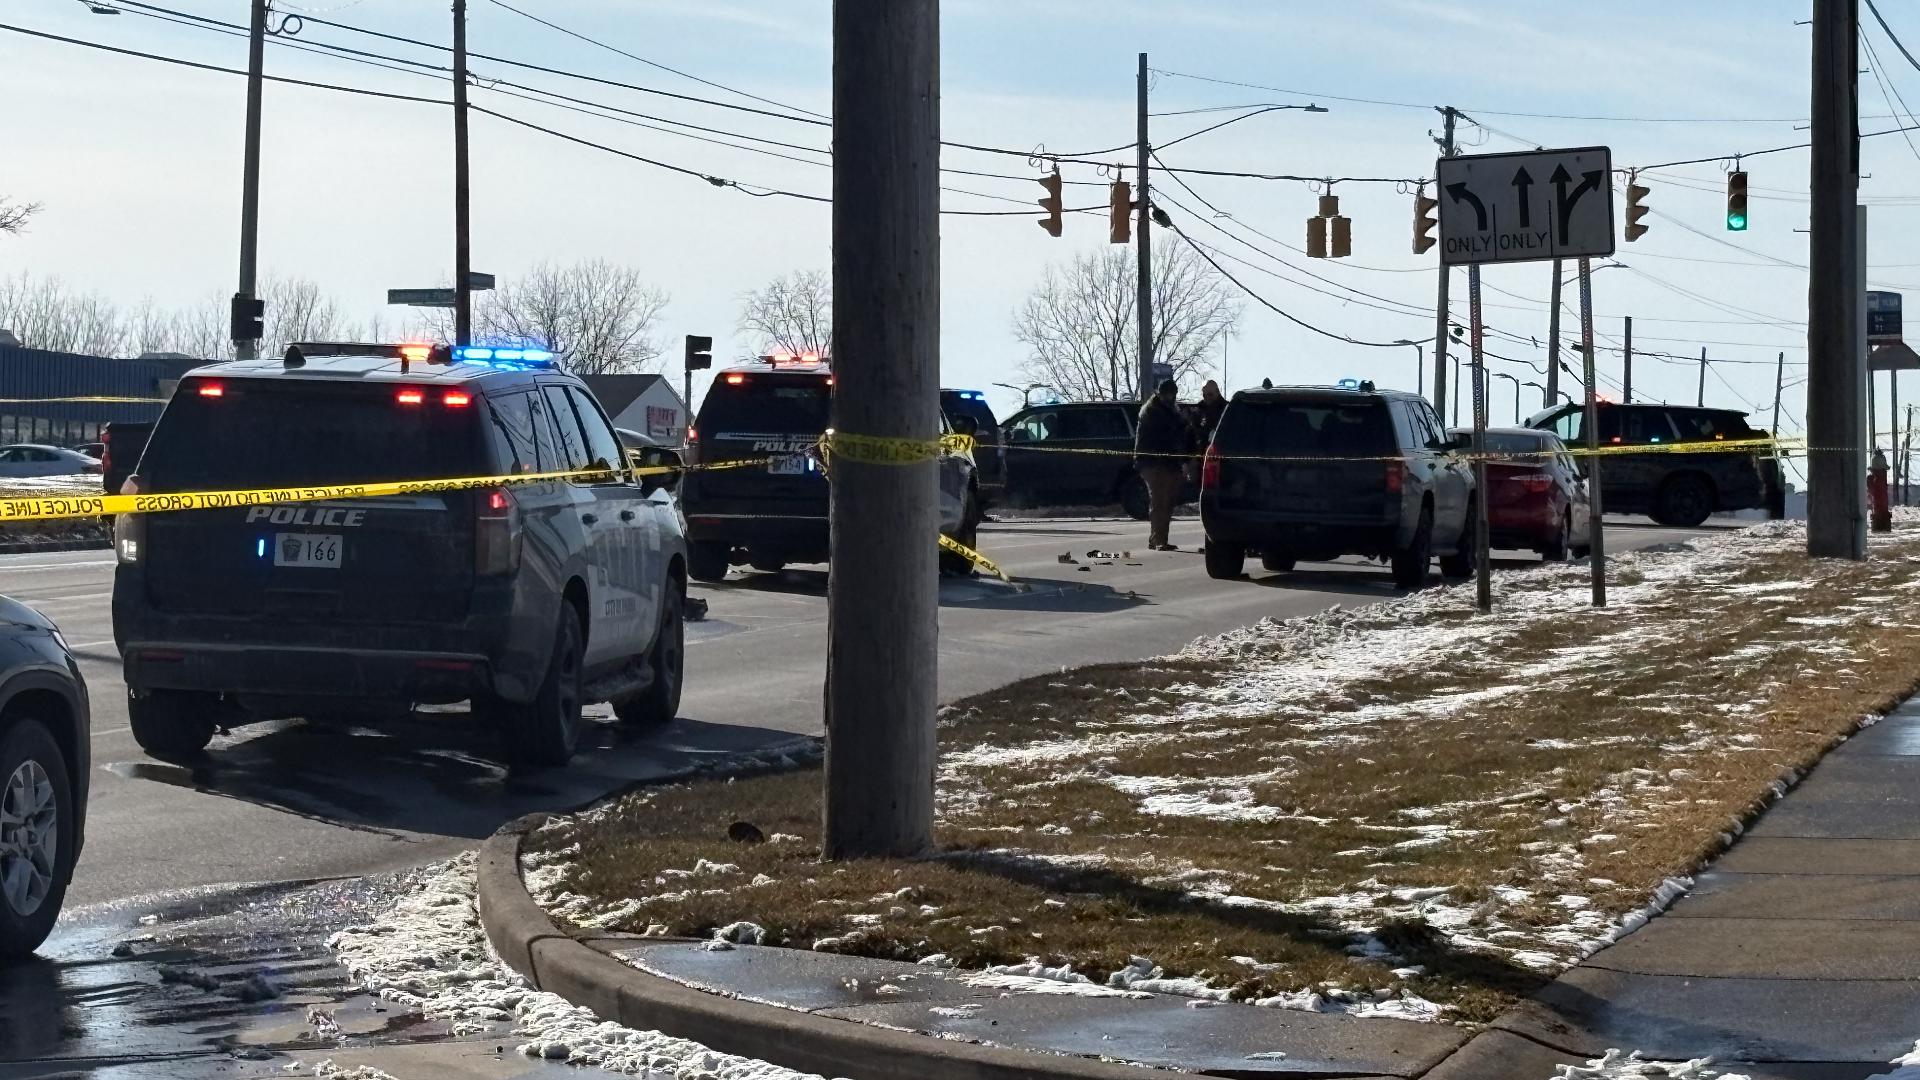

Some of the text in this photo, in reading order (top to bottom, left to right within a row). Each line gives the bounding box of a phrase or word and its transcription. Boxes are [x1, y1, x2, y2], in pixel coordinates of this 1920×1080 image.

[1446, 235, 1491, 254] ONLY
[1500, 231, 1548, 250] ONLY
[245, 506, 367, 527] POLICE
[306, 540, 336, 561] 166
